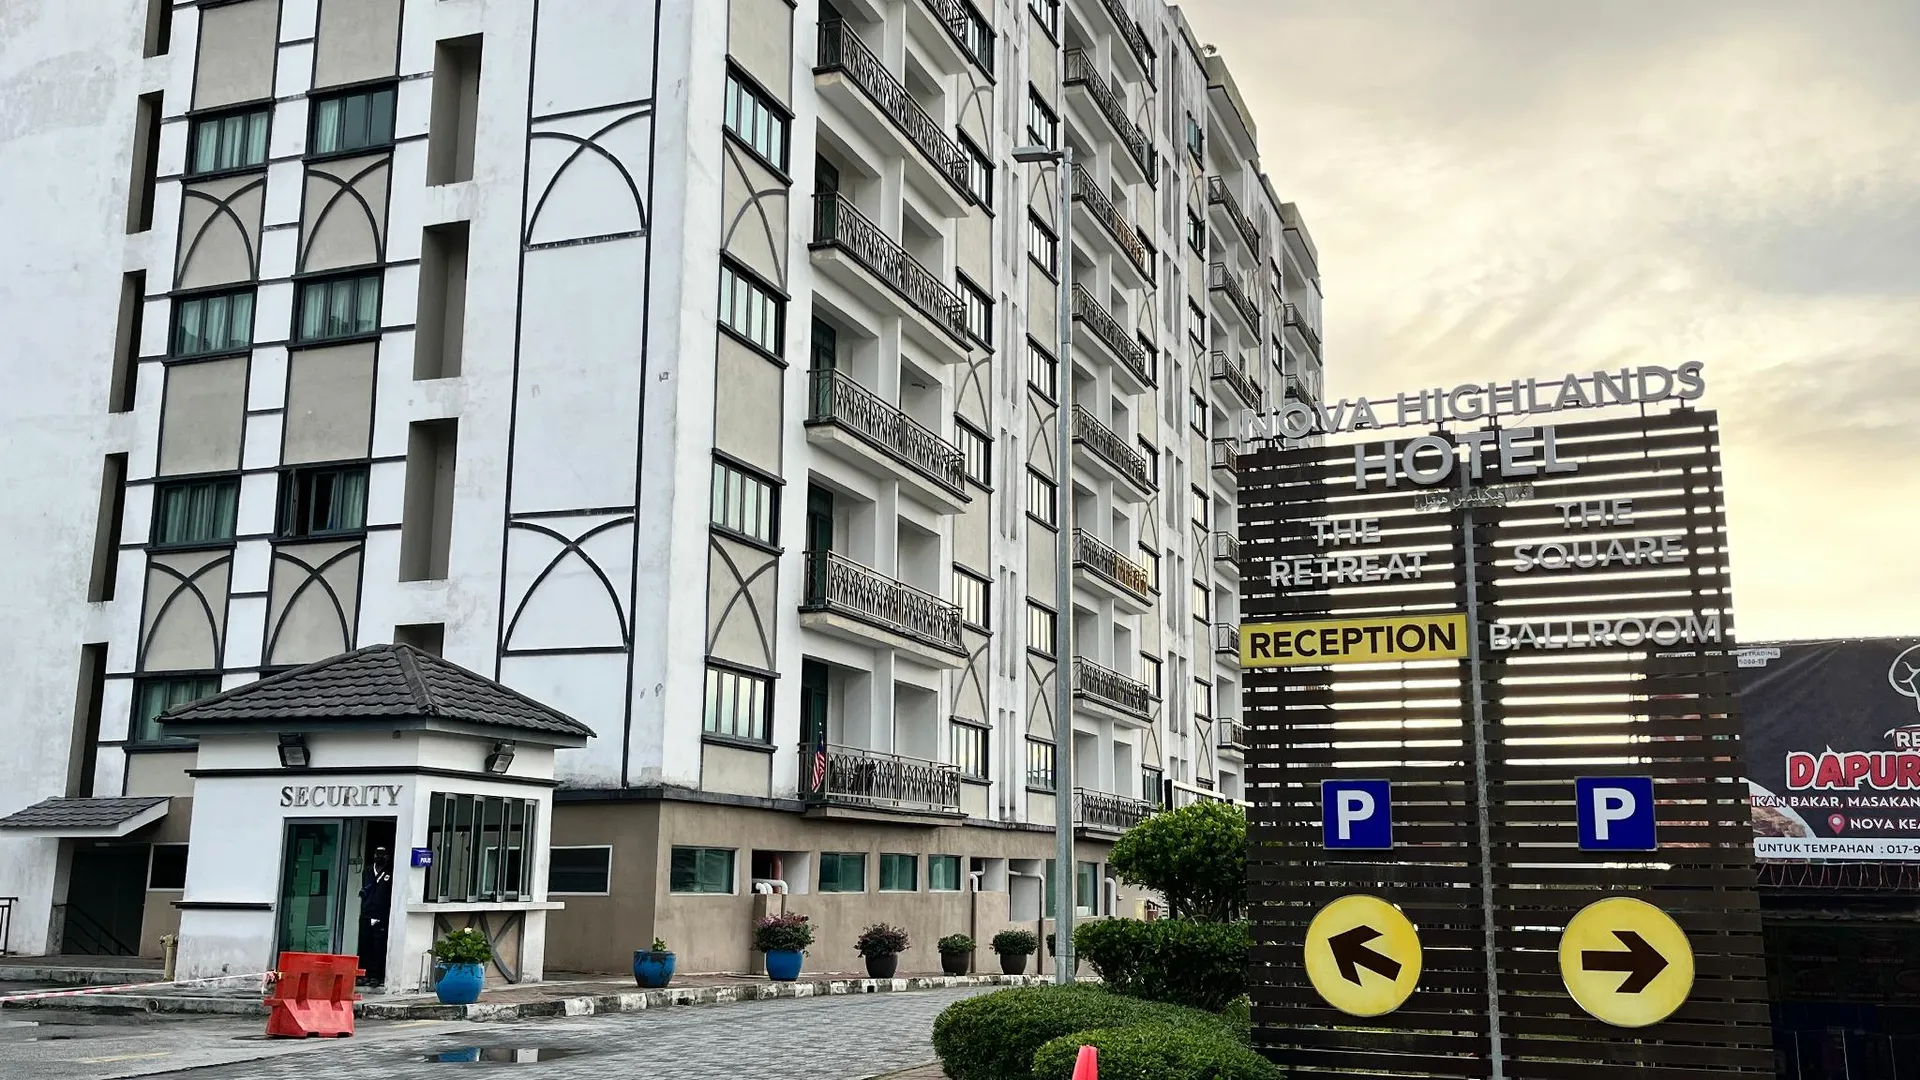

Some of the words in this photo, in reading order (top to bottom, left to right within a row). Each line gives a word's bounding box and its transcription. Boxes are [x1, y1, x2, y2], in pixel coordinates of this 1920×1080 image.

[1242, 396, 1382, 442] NOVA
[1397, 361, 1706, 426] HIGHLANDS
[1353, 425, 1579, 491] HOTEL
[1555, 498, 1635, 529] THE
[1310, 518, 1382, 547] THE
[1270, 552, 1428, 587] RETREAT
[1513, 535, 1685, 573] SQUARE
[1250, 623, 1457, 659] RECEPTION
[1489, 614, 1722, 652] BALLROOM
[1788, 752, 1920, 789] DAPUR
[280, 785, 403, 808] SECURITY
[1593, 787, 1636, 841] P
[1752, 796, 1786, 807] IKAN
[1791, 796, 1843, 808] BAKAR,
[1848, 796, 1920, 807] MASAKAN
[1337, 790, 1375, 840] P
[1850, 819, 1894, 830] NOVA
[1758, 843, 1801, 853] UNTUK
[1804, 844, 1874, 854] TEMPAHAN
